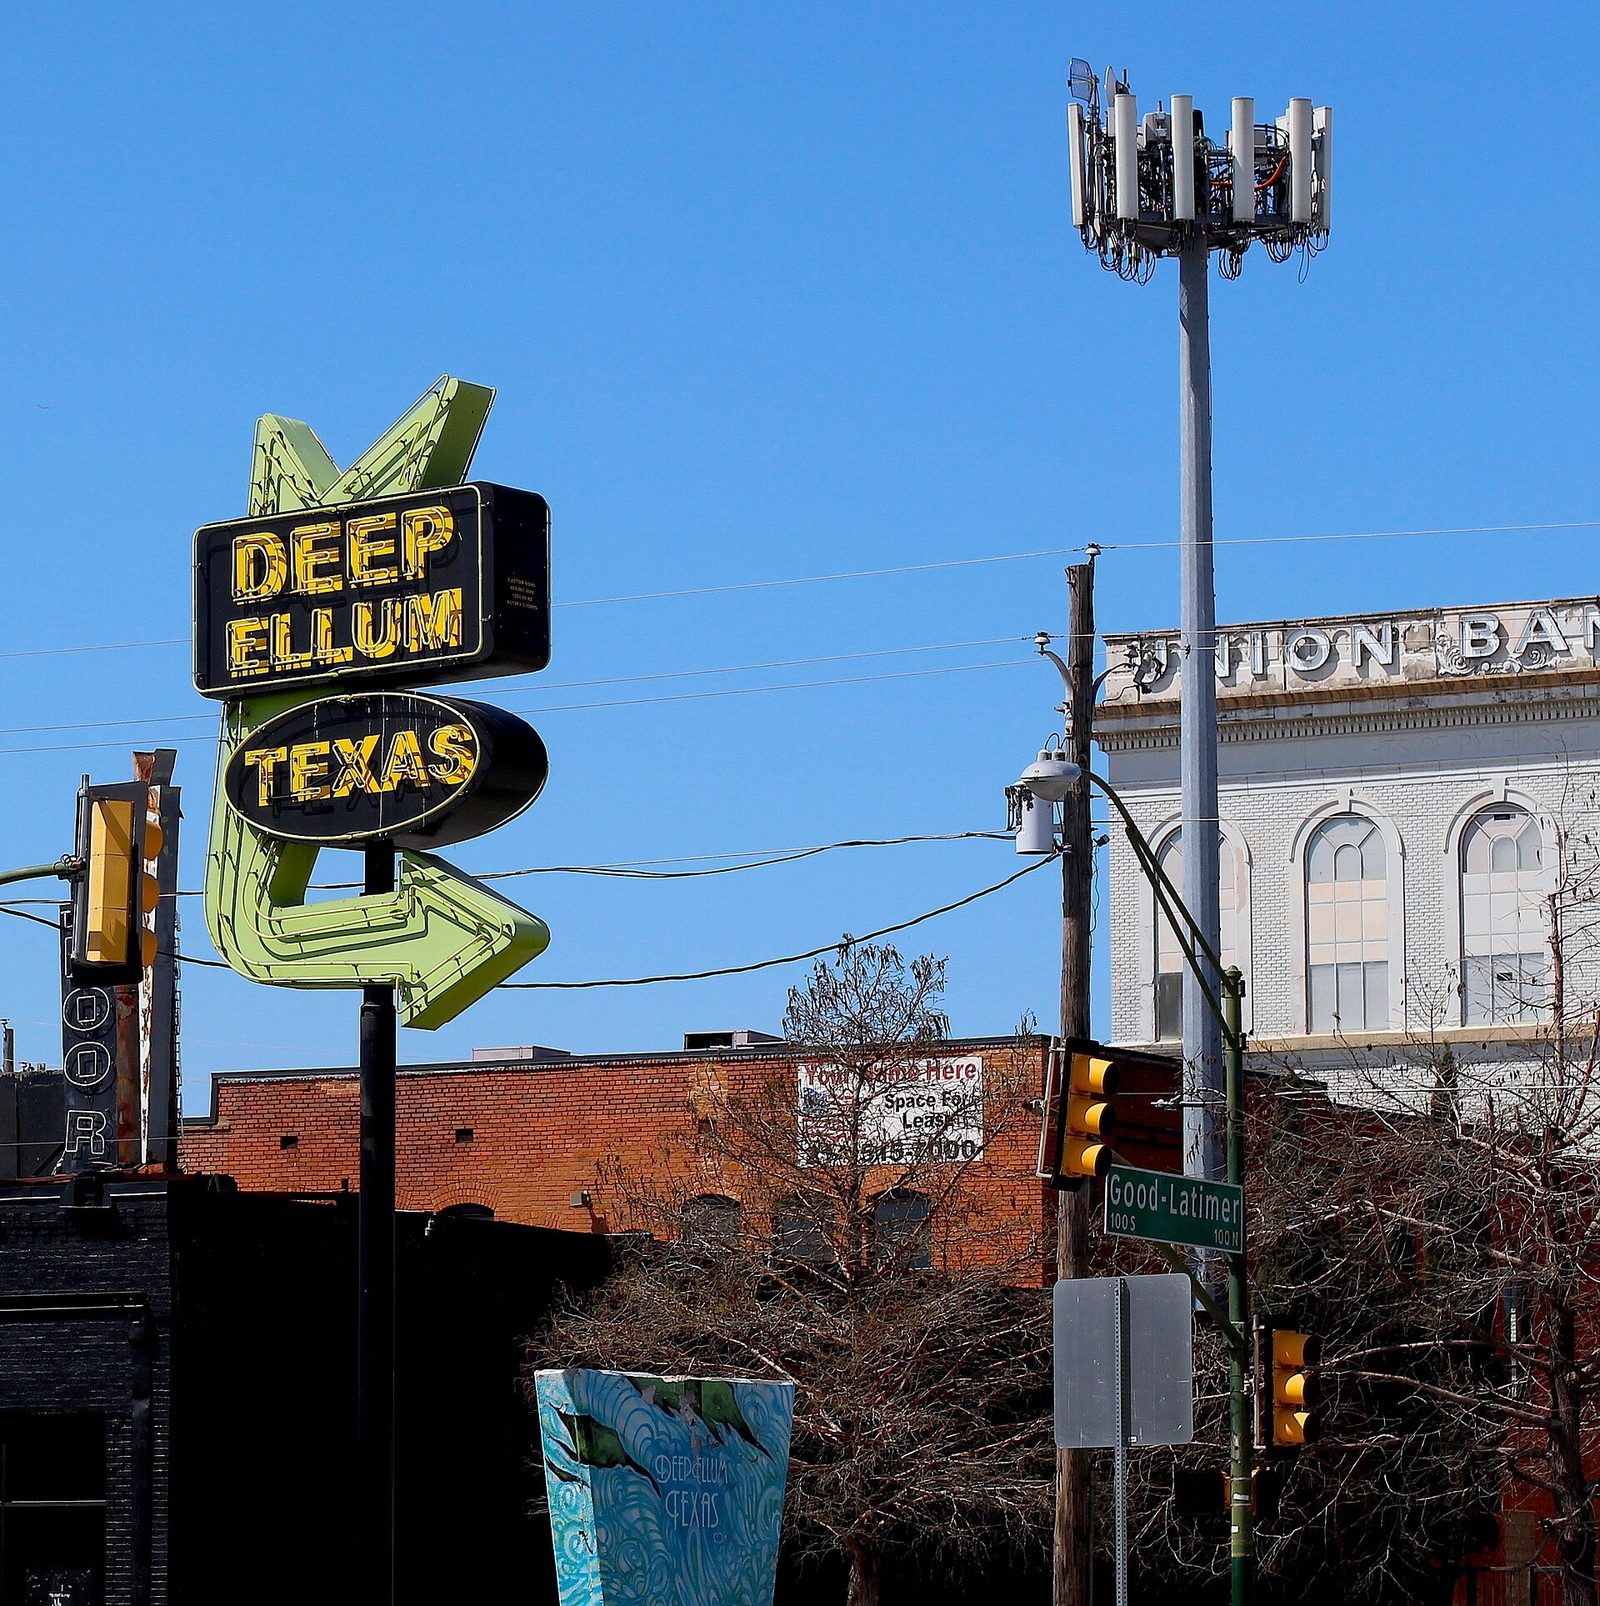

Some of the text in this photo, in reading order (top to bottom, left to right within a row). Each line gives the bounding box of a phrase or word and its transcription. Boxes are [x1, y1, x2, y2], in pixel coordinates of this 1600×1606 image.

[231, 504, 455, 606] DEEP
[225, 587, 463, 678] ELLUM
[244, 723, 475, 807] TEXAS
[926, 1060, 977, 1081] Here
[884, 1092, 936, 1112] Space
[1110, 1173, 1240, 1224] Good-Latimer
[664, 1489, 719, 1531] TEXAS
